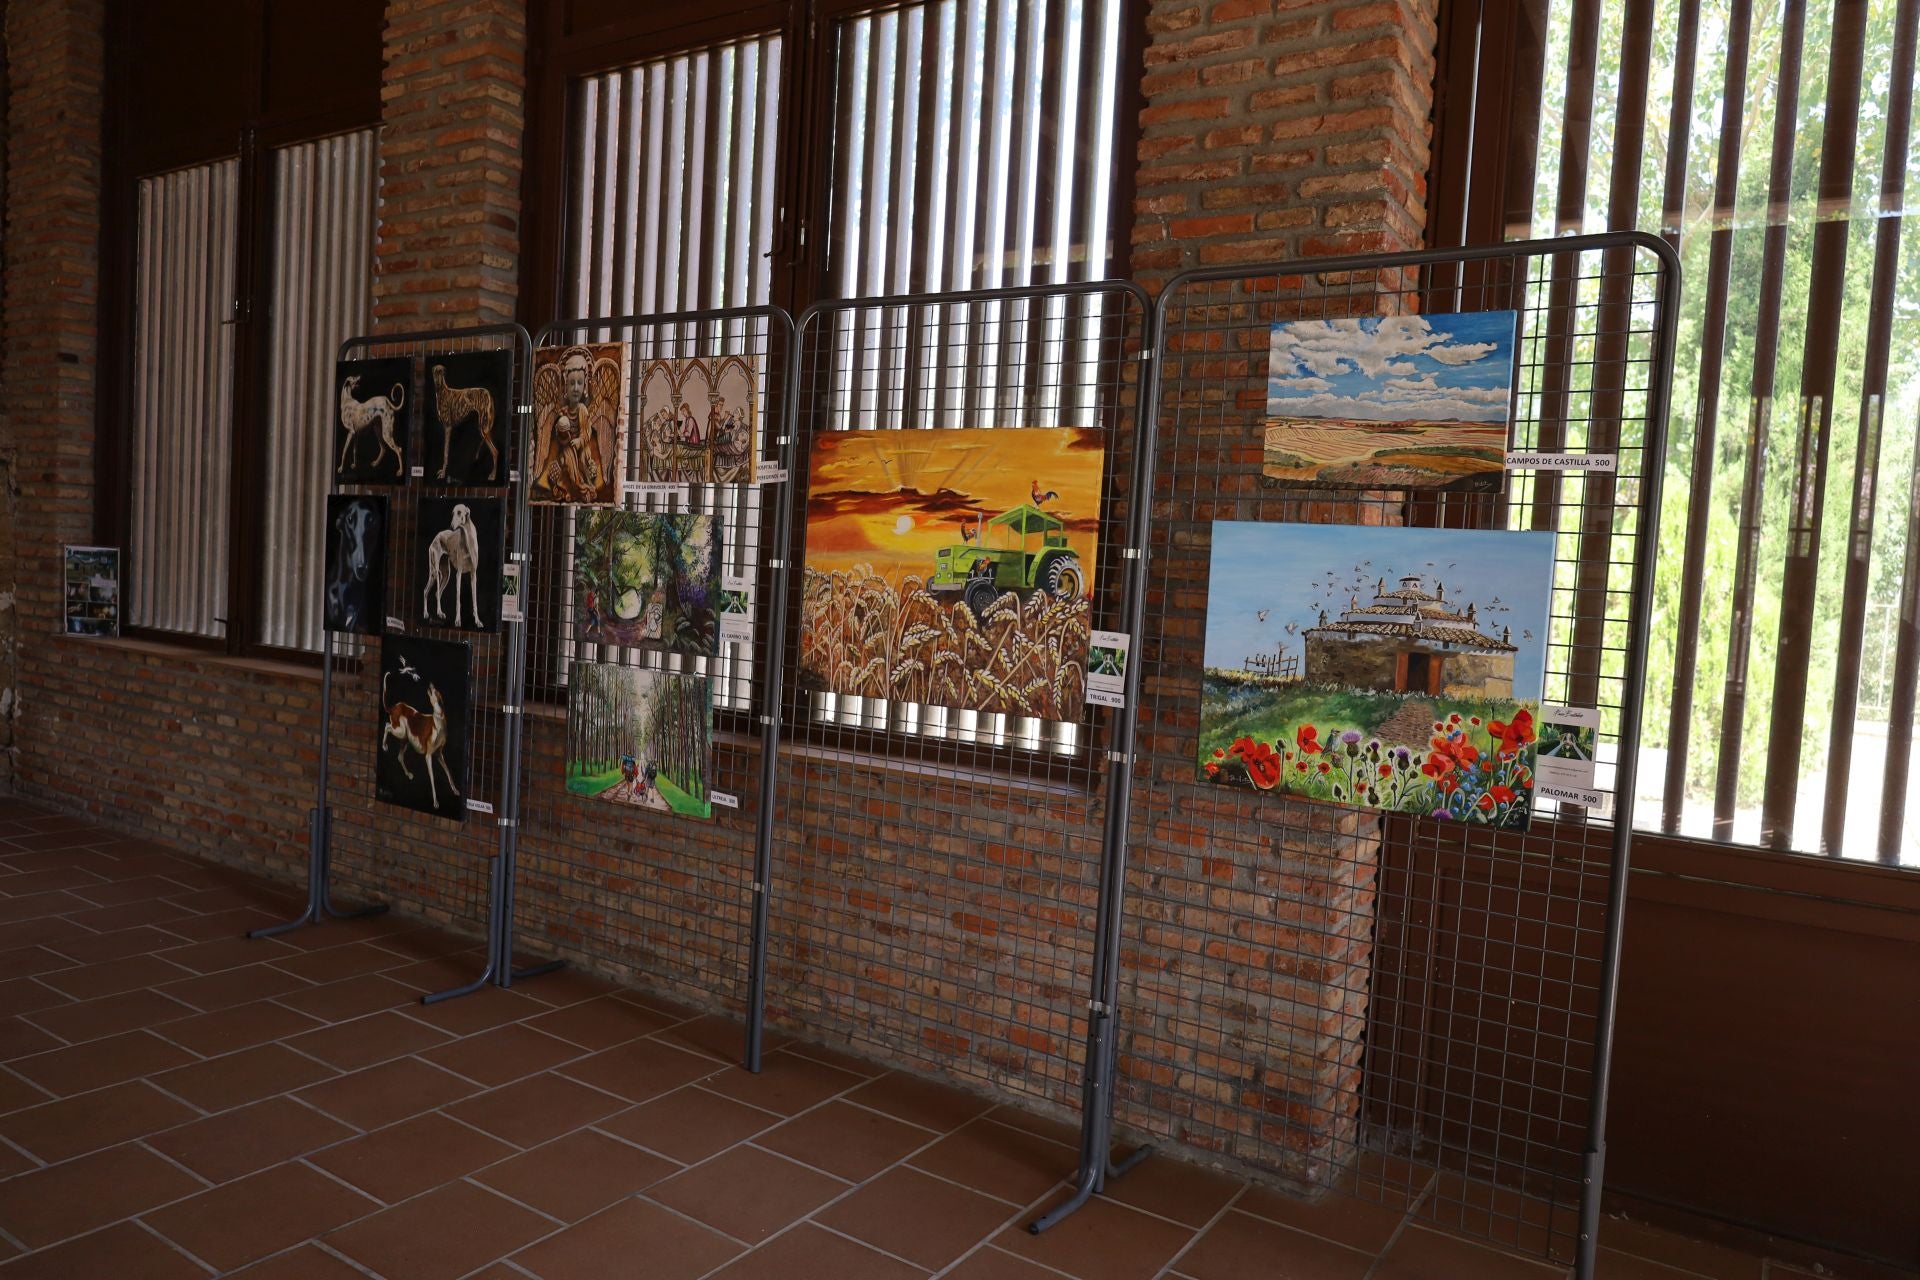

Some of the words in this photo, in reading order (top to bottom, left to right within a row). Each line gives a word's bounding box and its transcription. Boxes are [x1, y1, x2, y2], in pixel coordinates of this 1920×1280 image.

[1506, 457, 1540, 465] CAMPOS
[1554, 458, 1591, 466] CASTILLA
[1090, 693, 1108, 702] TRIGAL
[1540, 786, 1579, 800] PALOMAR
[1582, 795, 1597, 804] 500
